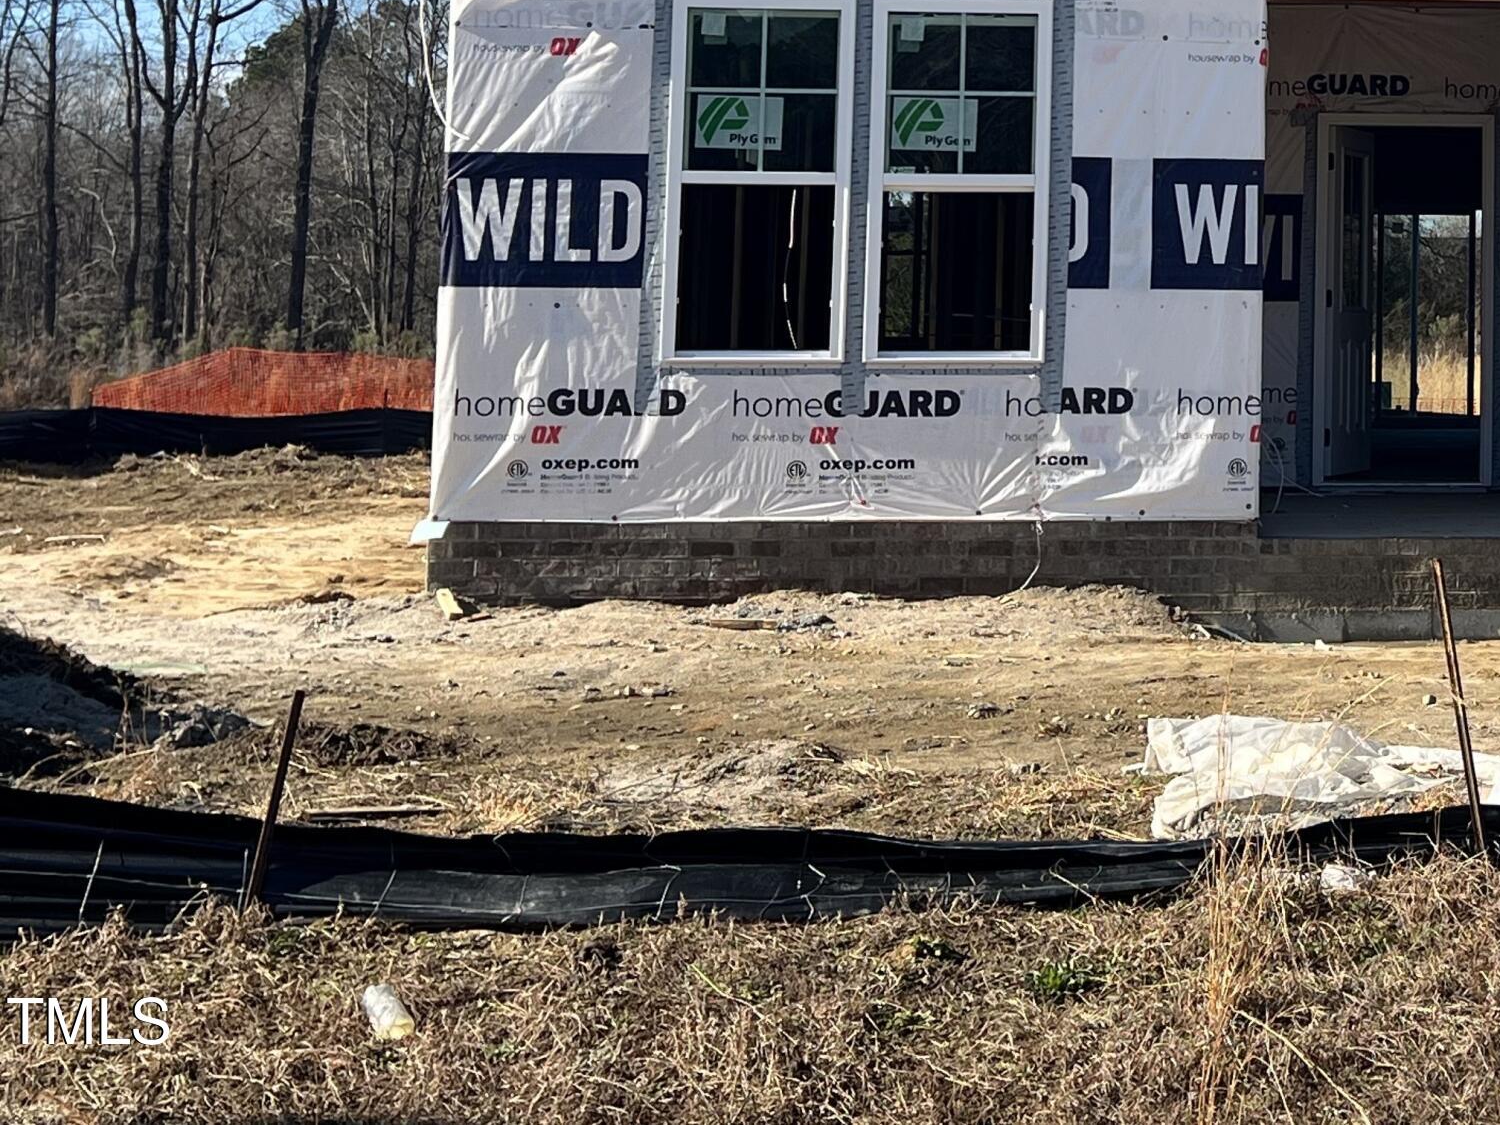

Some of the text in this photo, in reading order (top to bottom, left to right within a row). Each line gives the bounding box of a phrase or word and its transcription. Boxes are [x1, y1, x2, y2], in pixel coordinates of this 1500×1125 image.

[551, 37, 581, 56] OX
[1243, 52, 1256, 66] by
[729, 133, 777, 146] Ply Gm
[925, 134, 944, 147] Ply
[456, 177, 643, 263] WILD
[1175, 182, 1258, 265] WI
[454, 388, 687, 417] homeGUAD
[531, 425, 562, 445] OX
[791, 432, 805, 445] by
[809, 426, 840, 445] OX
[1232, 430, 1245, 444] by
[541, 458, 639, 472] oxep.com
[819, 458, 915, 473] oxep.com
